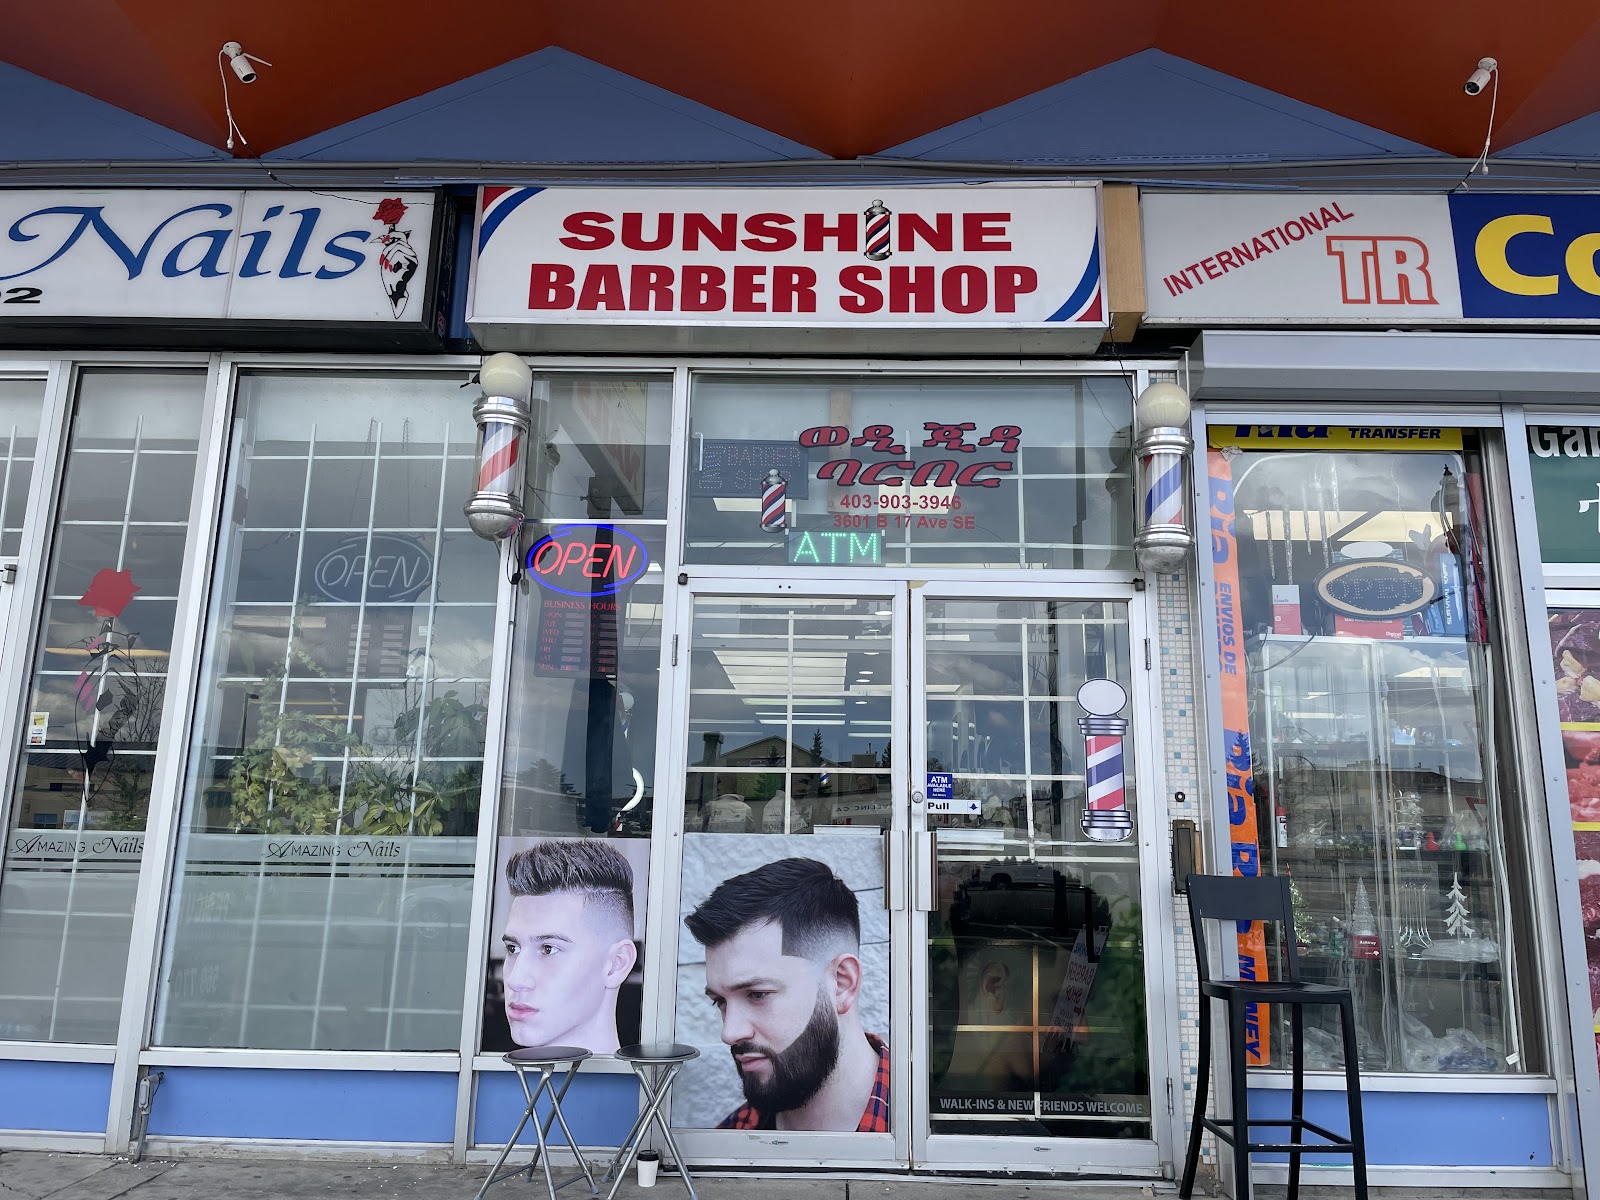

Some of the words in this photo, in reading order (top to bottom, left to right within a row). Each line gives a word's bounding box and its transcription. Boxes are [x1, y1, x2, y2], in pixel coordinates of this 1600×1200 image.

[0, 203, 371, 281] Nails
[1163, 201, 1354, 297] INTERNATIONAL
[1326, 235, 1439, 305] TR
[0, 287, 42, 303] 2
[528, 263, 817, 312] BARBER
[838, 265, 1037, 314] SHOP
[1349, 427, 1441, 439] TRANSFER
[840, 494, 962, 510] 403-903-3946
[833, 515, 870, 528] 3601
[876, 515, 888, 528] B
[894, 516, 912, 529] 17
[916, 515, 948, 529] Ave
[953, 516, 976, 530] SE
[793, 531, 879, 563] ATM
[533, 541, 637, 578] OPEN
[321, 554, 421, 589] OPEN
[1325, 576, 1424, 599] OPEN
[544, 600, 585, 610] BUSINESS
[589, 603, 622, 611] HOURS
[1219, 581, 1236, 648] ENVIOS
[1222, 652, 1238, 676] DE
[930, 776, 948, 784] ATM
[928, 802, 950, 810] Pull
[10, 835, 86, 853] AMAZING
[93, 837, 144, 854] Nails
[262, 840, 341, 859] AMAZING
[348, 841, 401, 858] Nails
[940, 1098, 995, 1110] WALK-INS
[997, 1099, 1006, 1110] &
[1008, 1099, 1034, 1112] NEW
[1039, 1100, 1085, 1112] FRIENDS
[1086, 1101, 1143, 1114] WELCOME
